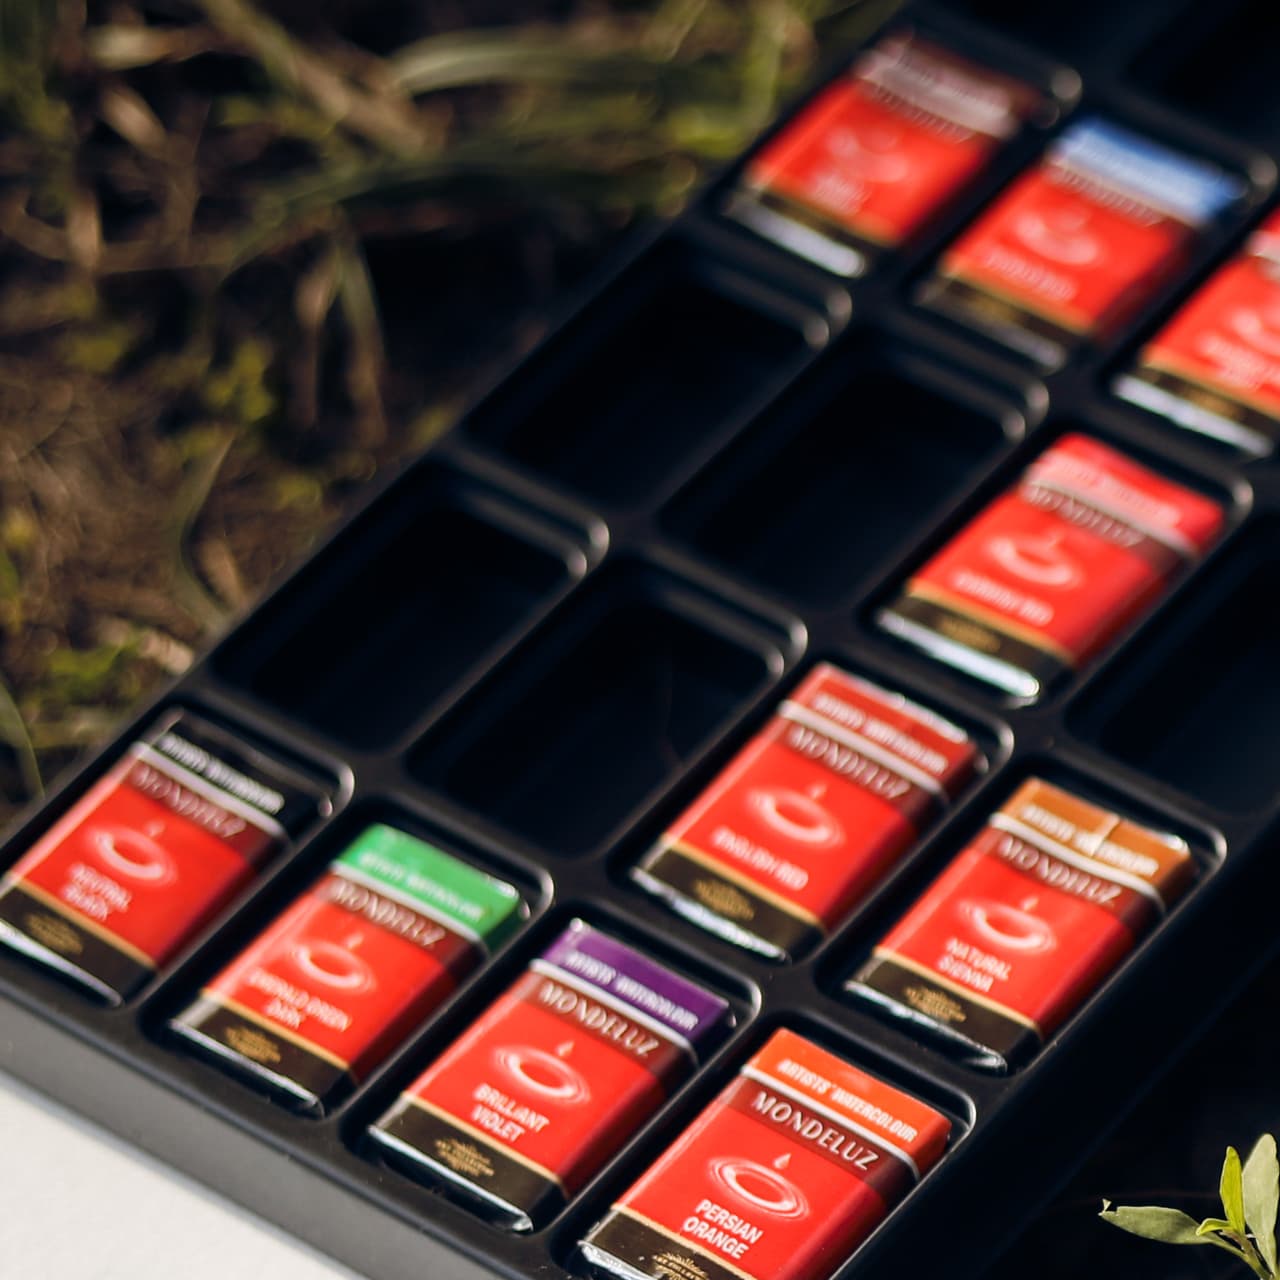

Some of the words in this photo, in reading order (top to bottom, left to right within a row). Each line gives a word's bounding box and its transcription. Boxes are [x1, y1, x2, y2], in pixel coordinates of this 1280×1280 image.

[936, 954, 995, 993] SIENNA
[944, 936, 1013, 982] NATURAL
[536, 981, 660, 1059] MONDELUZ
[469, 1102, 525, 1144] VIOLET
[472, 1082, 551, 1134] BRILLIANT
[749, 1089, 880, 1172] MONDELUZ
[829, 1086, 919, 1143] WATERCOLOUR
[681, 1213, 749, 1261] ORANGE
[694, 1198, 764, 1245] PERSIAN
